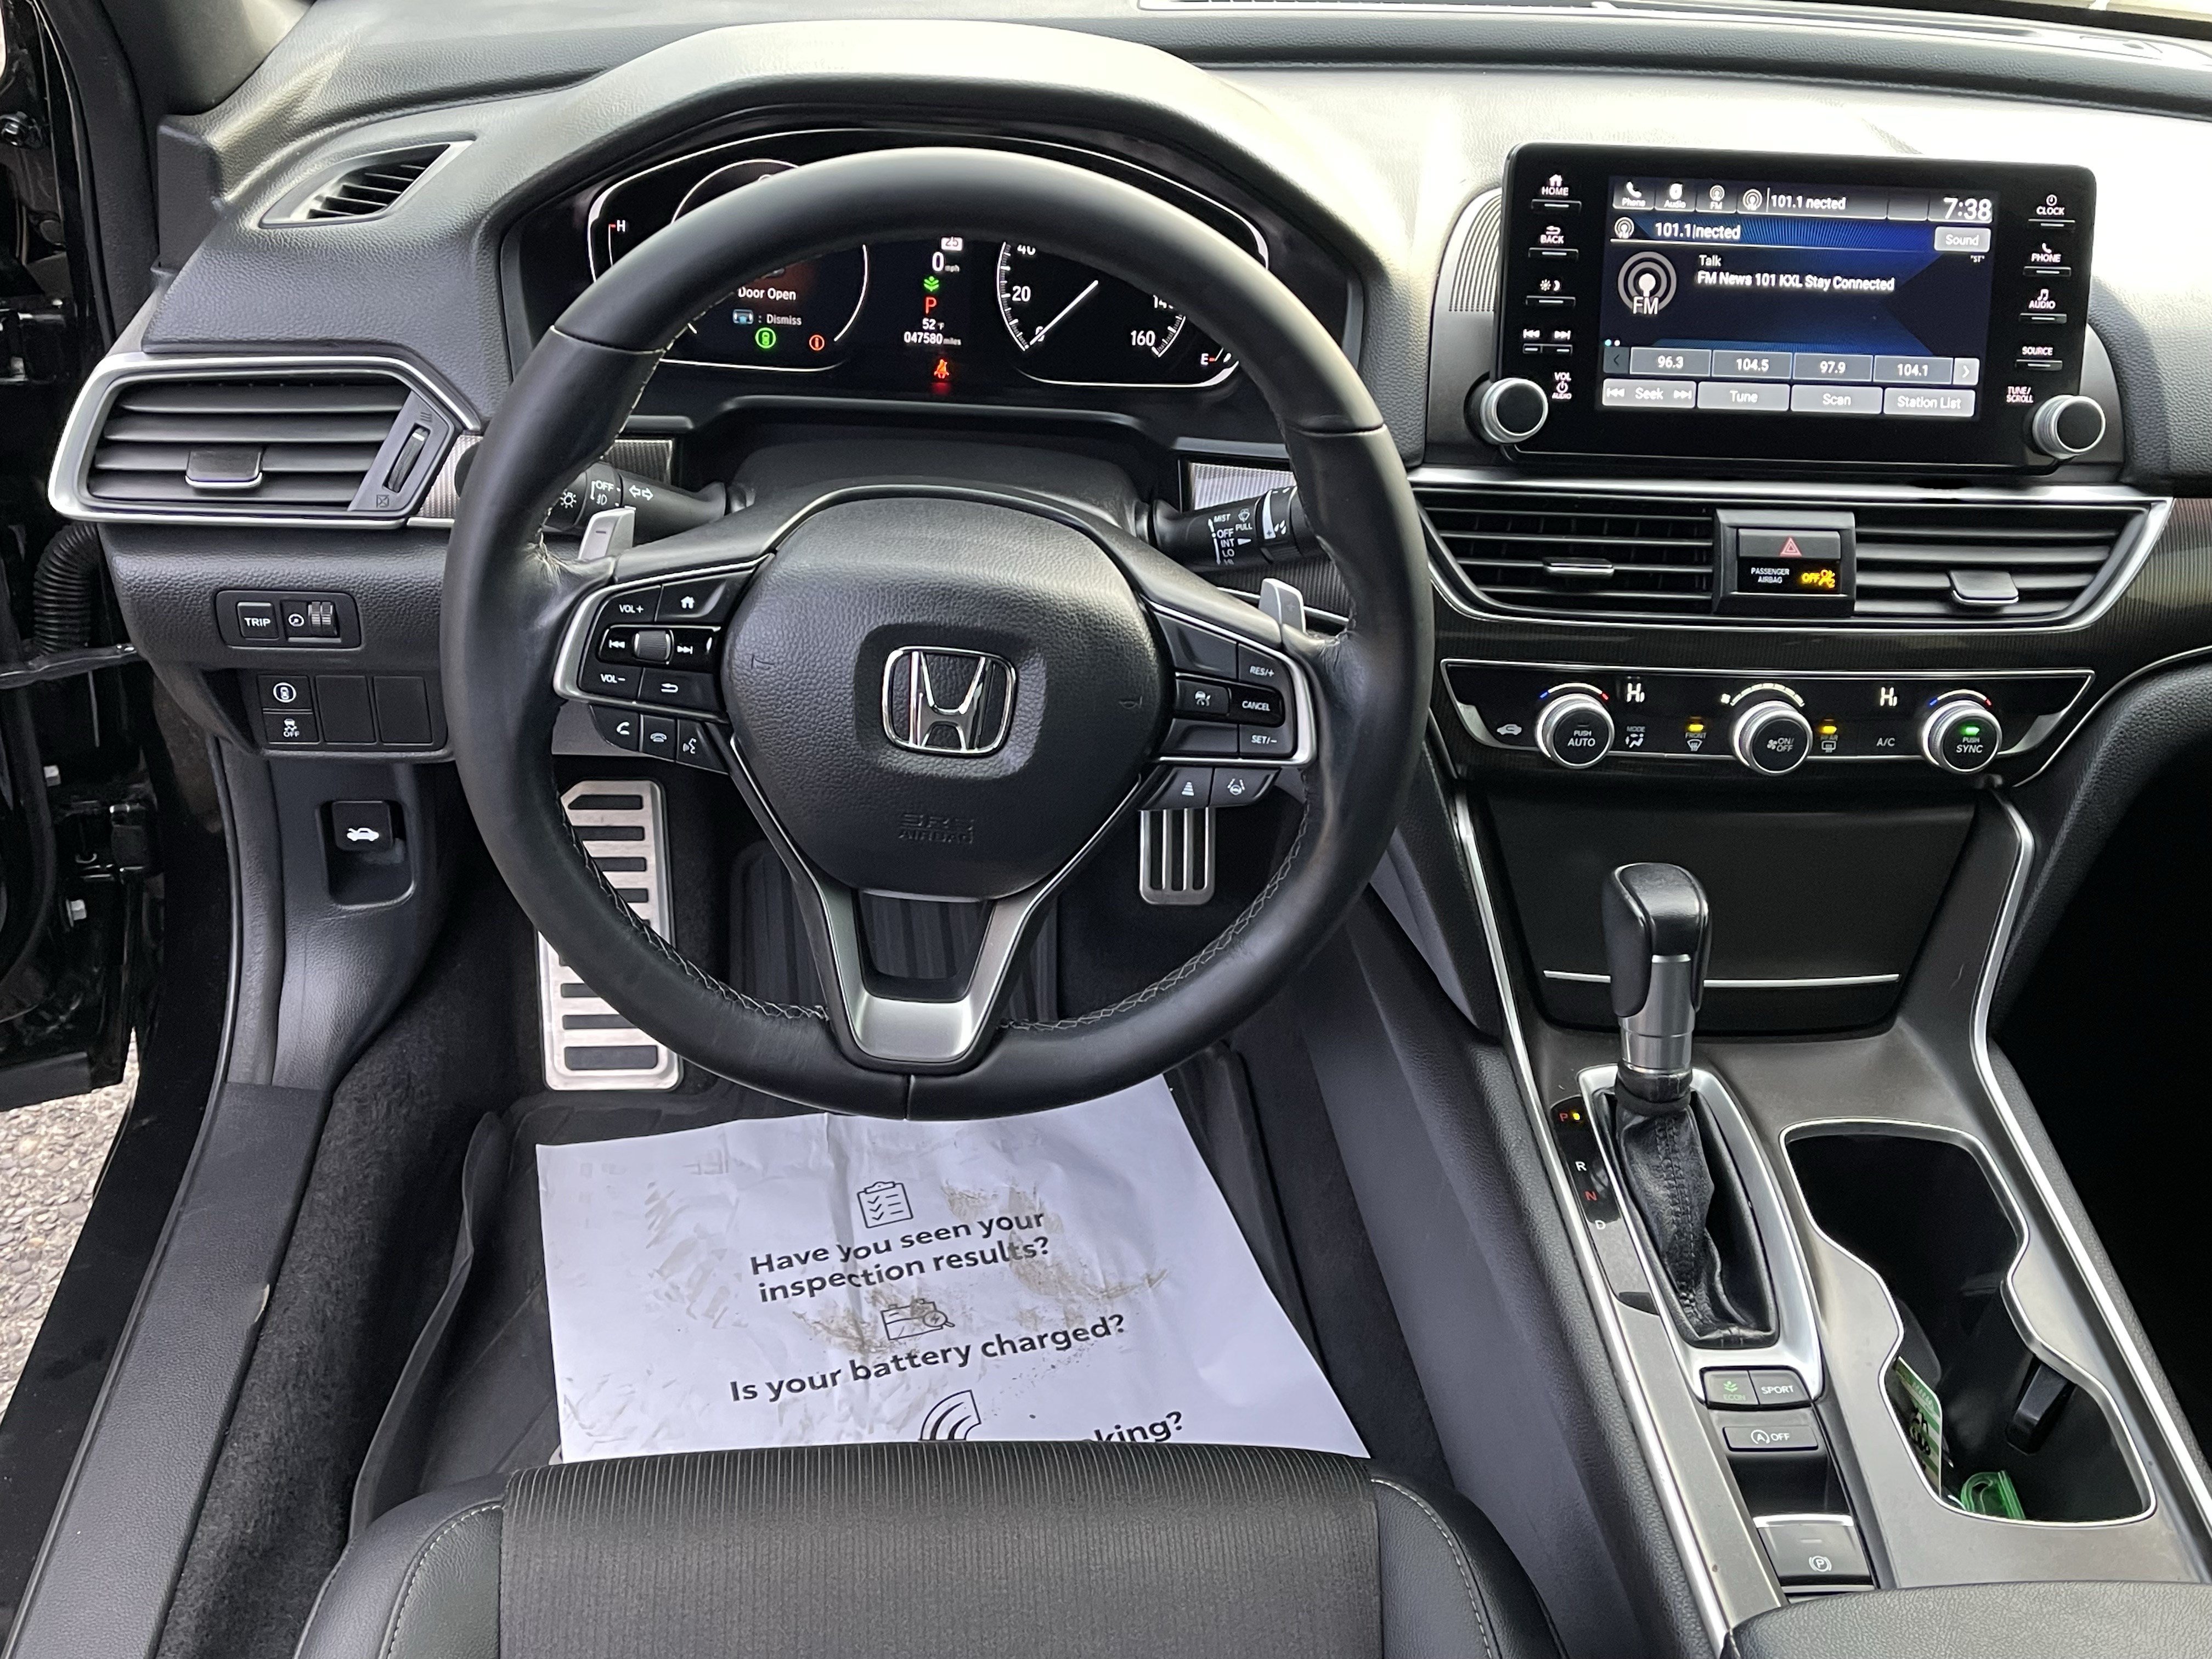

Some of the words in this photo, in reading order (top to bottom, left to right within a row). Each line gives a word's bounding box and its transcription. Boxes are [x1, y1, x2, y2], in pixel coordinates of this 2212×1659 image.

[1542, 187, 1568, 196] HOME
[1622, 198, 1646, 207] Phone
[1664, 200, 1686, 209] Audio
[1710, 201, 1723, 210] FM
[1771, 195, 1803, 208] 101.1
[1807, 198, 1846, 210] nected
[1943, 197, 1991, 220] 7:38
[2036, 206, 2064, 216] CLOCK
[616, 219, 626, 233] H
[1540, 235, 1564, 244] BACK
[1945, 234, 1979, 246] Sound
[1017, 245, 1036, 256] 40
[932, 251, 945, 272] 0
[945, 264, 960, 273] mph
[1699, 255, 1721, 266] Talk
[2031, 253, 2061, 263] PHONE
[1698, 272, 1717, 284] FM
[1720, 274, 1752, 286] News
[1756, 274, 1775, 286] 101
[1779, 275, 1802, 287] KXL
[1805, 276, 1830, 292] Stay
[1833, 276, 1894, 291] Connected
[737, 286, 765, 300] Door
[768, 288, 796, 302] Open
[1012, 286, 1031, 302] 20
[925, 296, 937, 314] P
[1153, 294, 1174, 309] 14
[1633, 297, 1659, 315] FM
[2029, 300, 2056, 309] AUDIO
[766, 314, 802, 326] Dismiss
[922, 318, 936, 330] 52
[904, 331, 943, 345] 047580
[1131, 330, 1156, 346] 160
[2022, 347, 2053, 356] SOURCE
[1200, 353, 1209, 365] E
[1657, 356, 1684, 369] 96.3
[1736, 358, 1769, 371] 104.5
[1820, 361, 1846, 374] 97.9
[1897, 364, 1929, 376] 104.1
[1554, 372, 1571, 381] VOL
[1552, 392, 1572, 400] AUDIO
[1635, 387, 1663, 400] Seek
[1730, 390, 1758, 403] Tune
[2008, 386, 2032, 396] TUNE/
[1822, 394, 1852, 406] Scan
[1897, 396, 1937, 409] Station
[1940, 398, 1961, 409] List
[2006, 394, 2034, 404] SCROLL
[595, 481, 614, 492] OFF
[1214, 514, 1231, 522] MIST
[1235, 523, 1252, 531] PULL
[1216, 528, 1234, 539] OFF
[1220, 538, 1234, 548] INT
[1222, 549, 1235, 557] LO
[1751, 567, 1790, 576] PASSENGER
[1758, 575, 1783, 584] AIRBAG
[1802, 572, 1821, 583] OFF
[244, 617, 270, 628] TRIP
[1242, 700, 1271, 712] CANCEL
[1567, 737, 1596, 748] AUTO
[1778, 737, 1795, 745] ON/
[1876, 737, 1895, 747] A/C
[1776, 743, 1793, 752] OFF
[1956, 744, 1984, 754] SYNC
[1559, 1113, 1568, 1122] P
[1575, 1161, 1587, 1171] R
[1585, 1190, 1598, 1201] N
[1594, 1220, 1606, 1230] D
[751, 1244, 831, 1276] Have
[837, 1235, 893, 1263] you
[900, 1221, 971, 1250] seen
[978, 1209, 1045, 1239] your
[758, 1257, 926, 1303] inspection
[933, 1235, 1050, 1273] results?
[730, 1379, 758, 1402] Is
[768, 1368, 842, 1402] your
[850, 1342, 972, 1383] battery
[980, 1313, 1126, 1359] charged?
[1760, 1385, 1795, 1395] SPORT
[1093, 1410, 1183, 1443] king?
[1770, 1432, 1791, 1441] OFF
